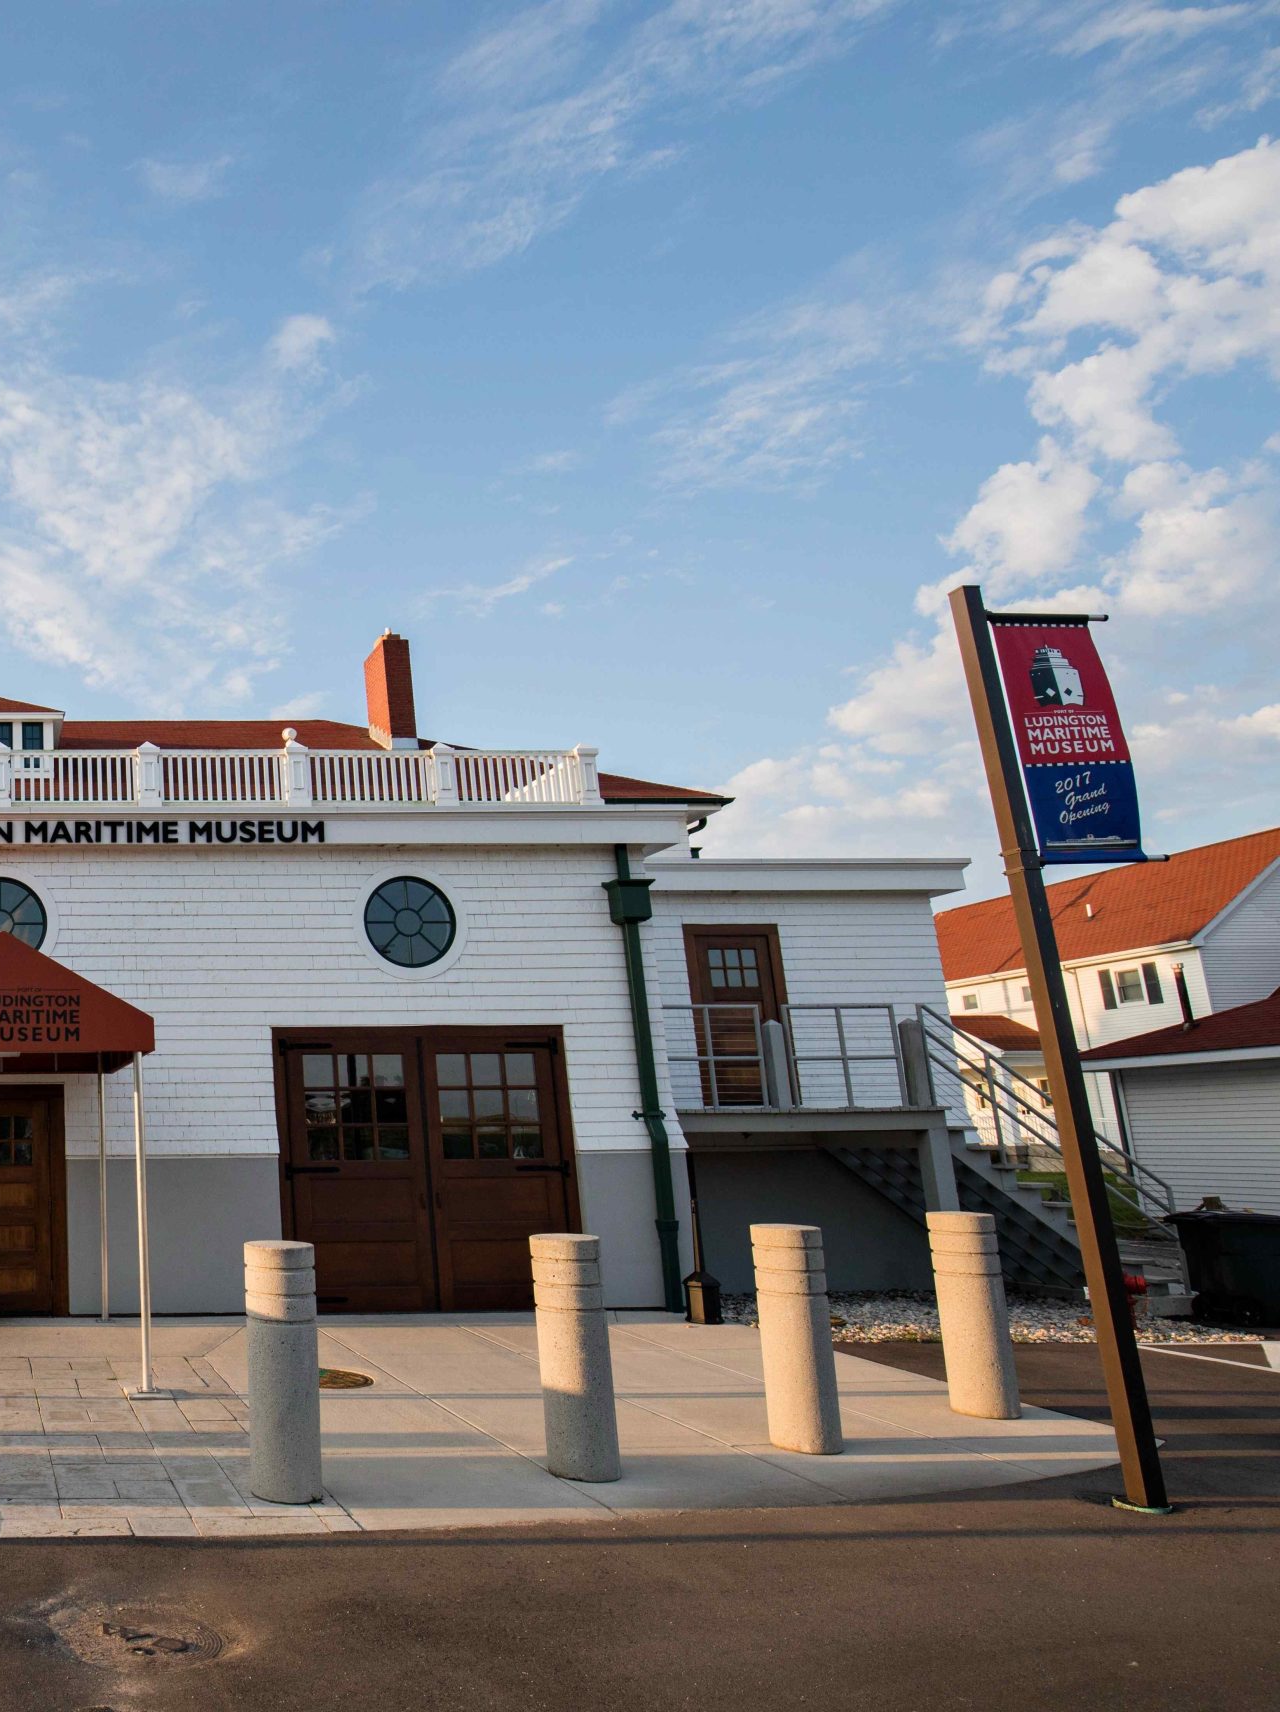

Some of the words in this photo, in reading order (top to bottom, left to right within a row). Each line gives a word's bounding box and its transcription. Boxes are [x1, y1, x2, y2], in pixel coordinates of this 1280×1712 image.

[1024, 715, 1107, 727] LUDINGTON
[1027, 726, 1111, 740] MARITIME
[1030, 740, 1115, 755] MUSEUM
[1055, 771, 1091, 794] 2017
[1065, 783, 1107, 810] Grand
[1059, 802, 1110, 825] Opening
[24, 821, 179, 843] MARITIME
[188, 821, 325, 843] MUSEUM
